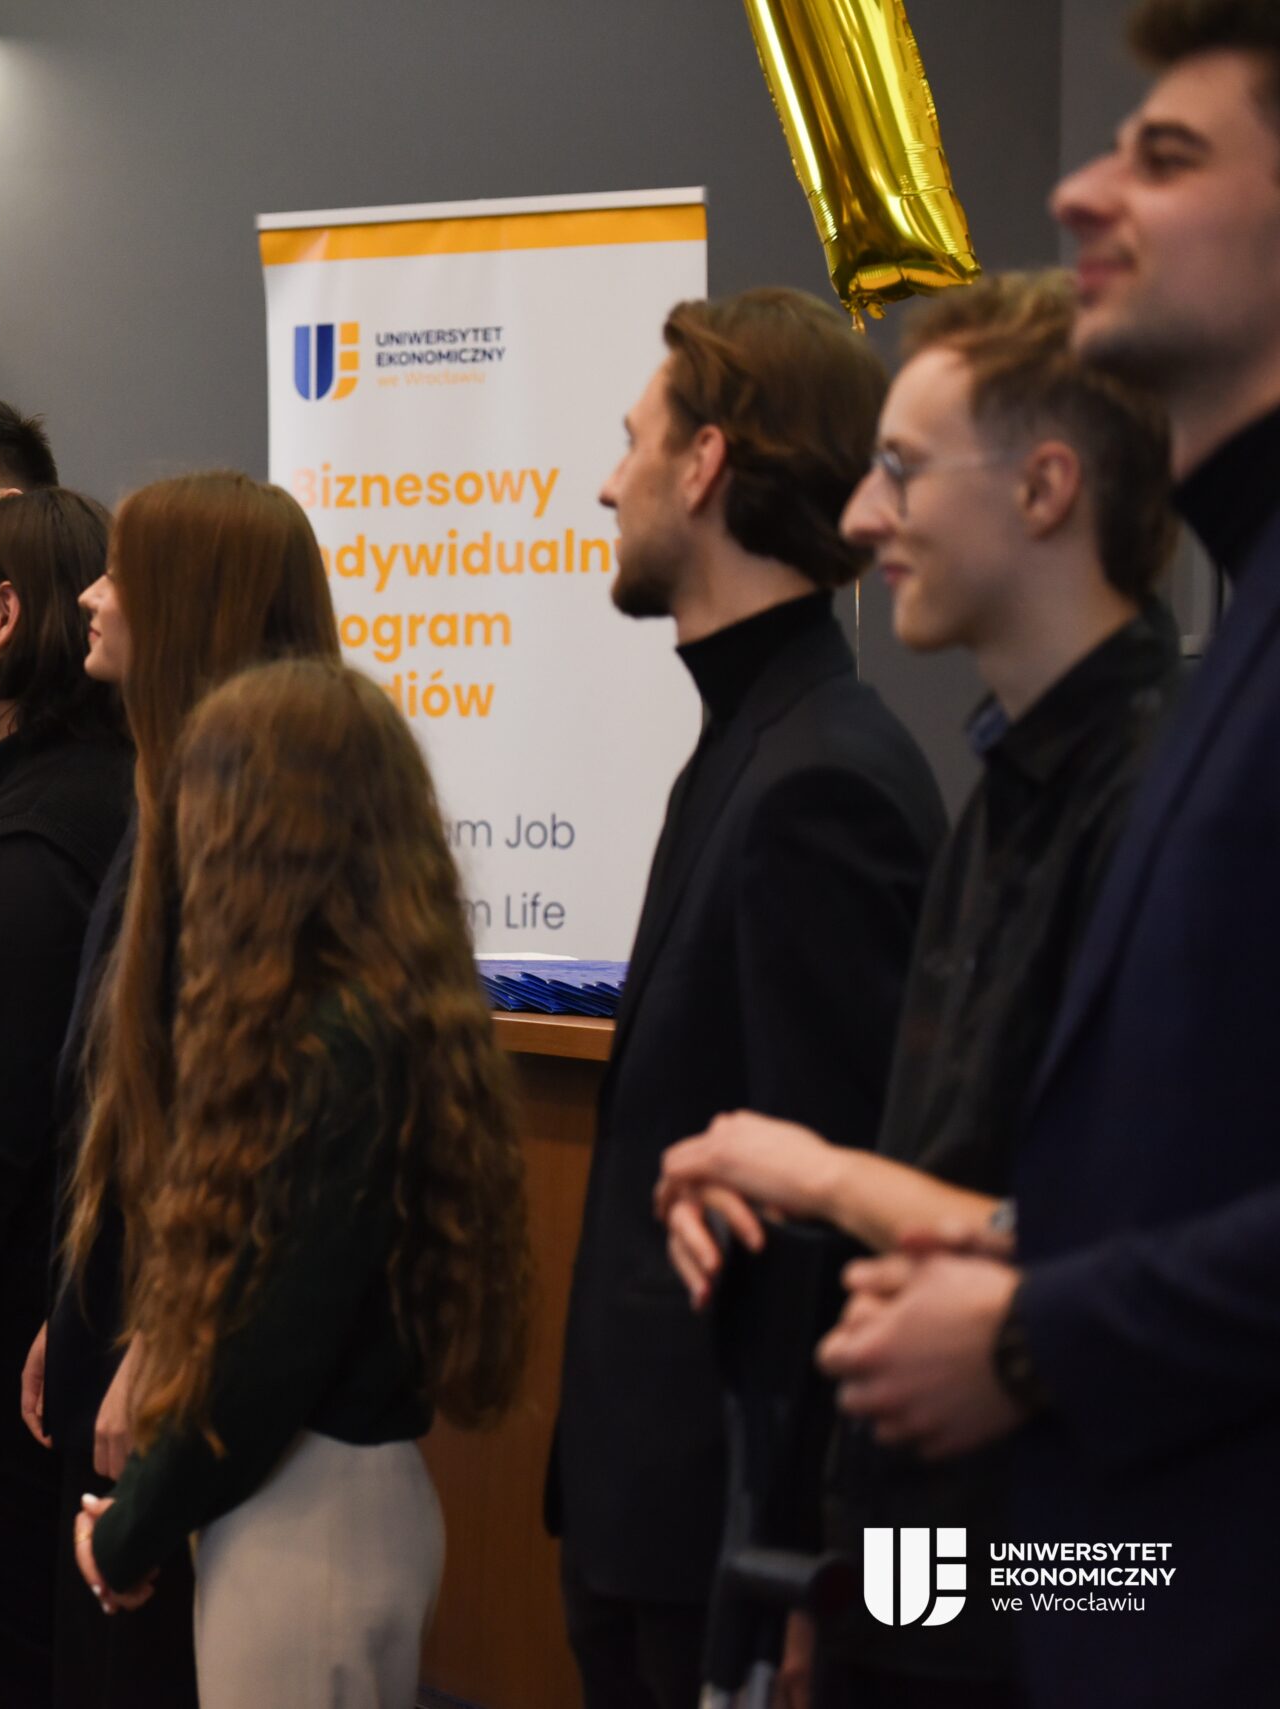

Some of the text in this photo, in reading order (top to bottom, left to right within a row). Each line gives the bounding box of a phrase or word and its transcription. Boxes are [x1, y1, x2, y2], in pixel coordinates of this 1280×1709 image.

[375, 326, 503, 347] UNIWERSYTET
[375, 346, 506, 368] EKONOMICZNY
[293, 462, 560, 519] Biznesowy
[321, 527, 622, 593] dywidualn
[339, 612, 513, 664] ogram
[505, 813, 575, 849] Job
[505, 891, 566, 930] Life
